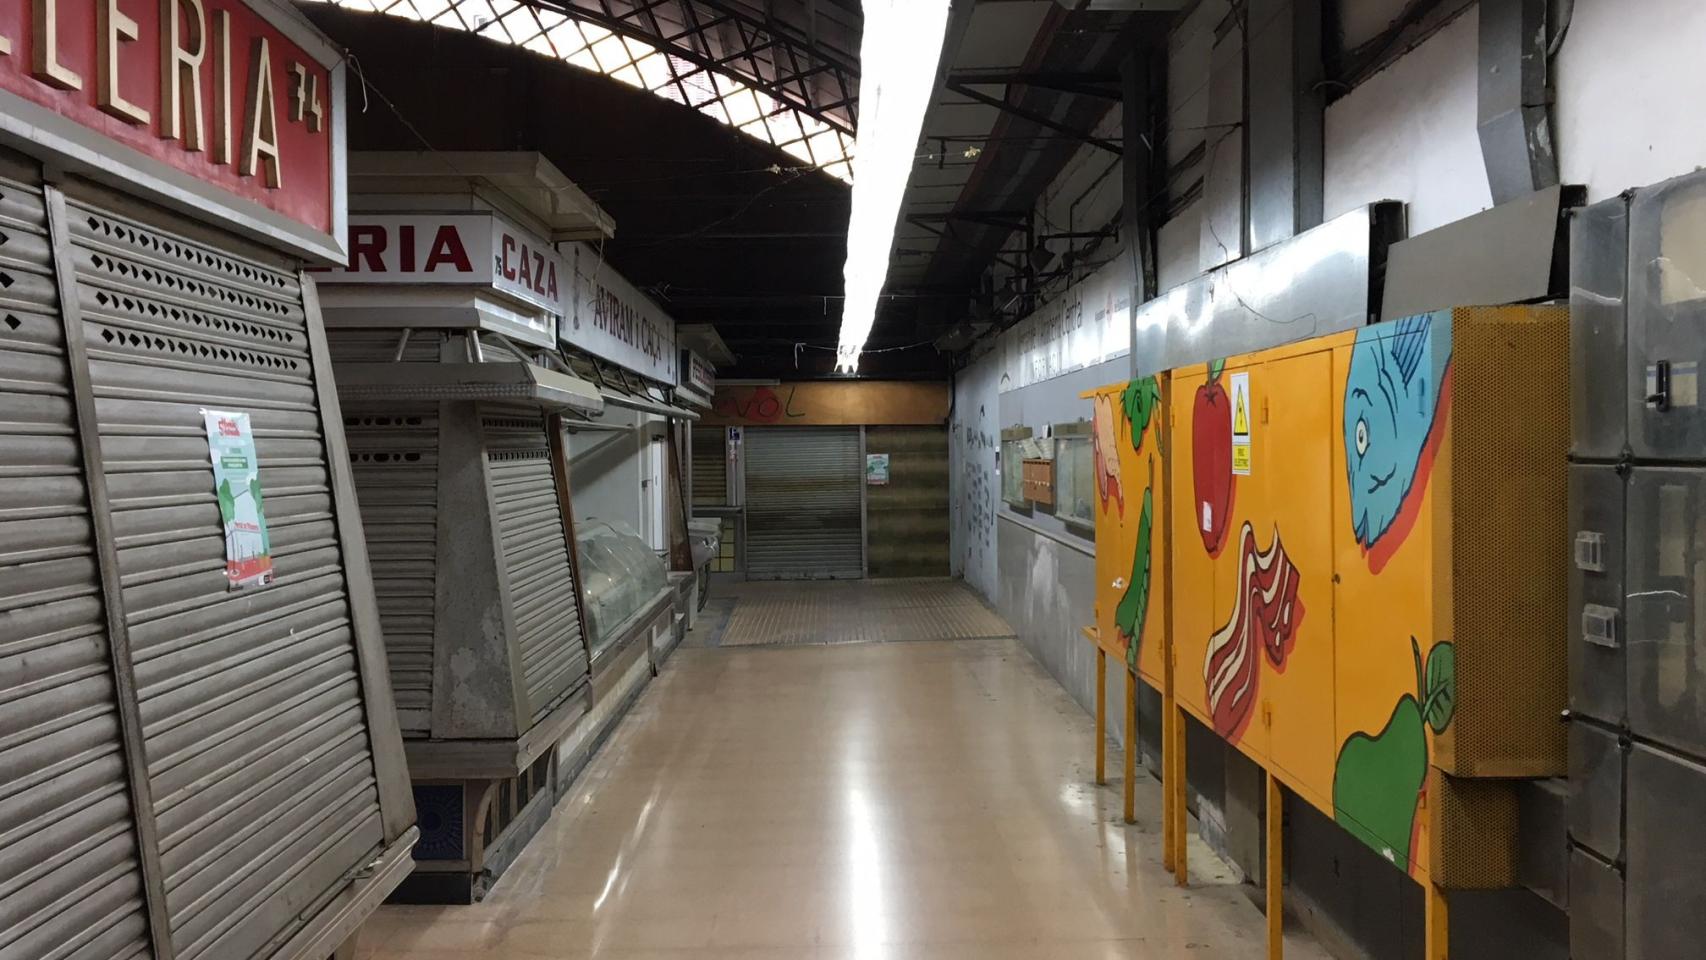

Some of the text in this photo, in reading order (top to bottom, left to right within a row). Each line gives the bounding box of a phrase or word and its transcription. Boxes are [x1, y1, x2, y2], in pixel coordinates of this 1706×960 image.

[0, 0, 281, 189] LERIA
[288, 62, 322, 132] 74
[304, 225, 474, 273] RIA
[502, 233, 558, 303] CAZA
[593, 284, 633, 347] AVIRAM
